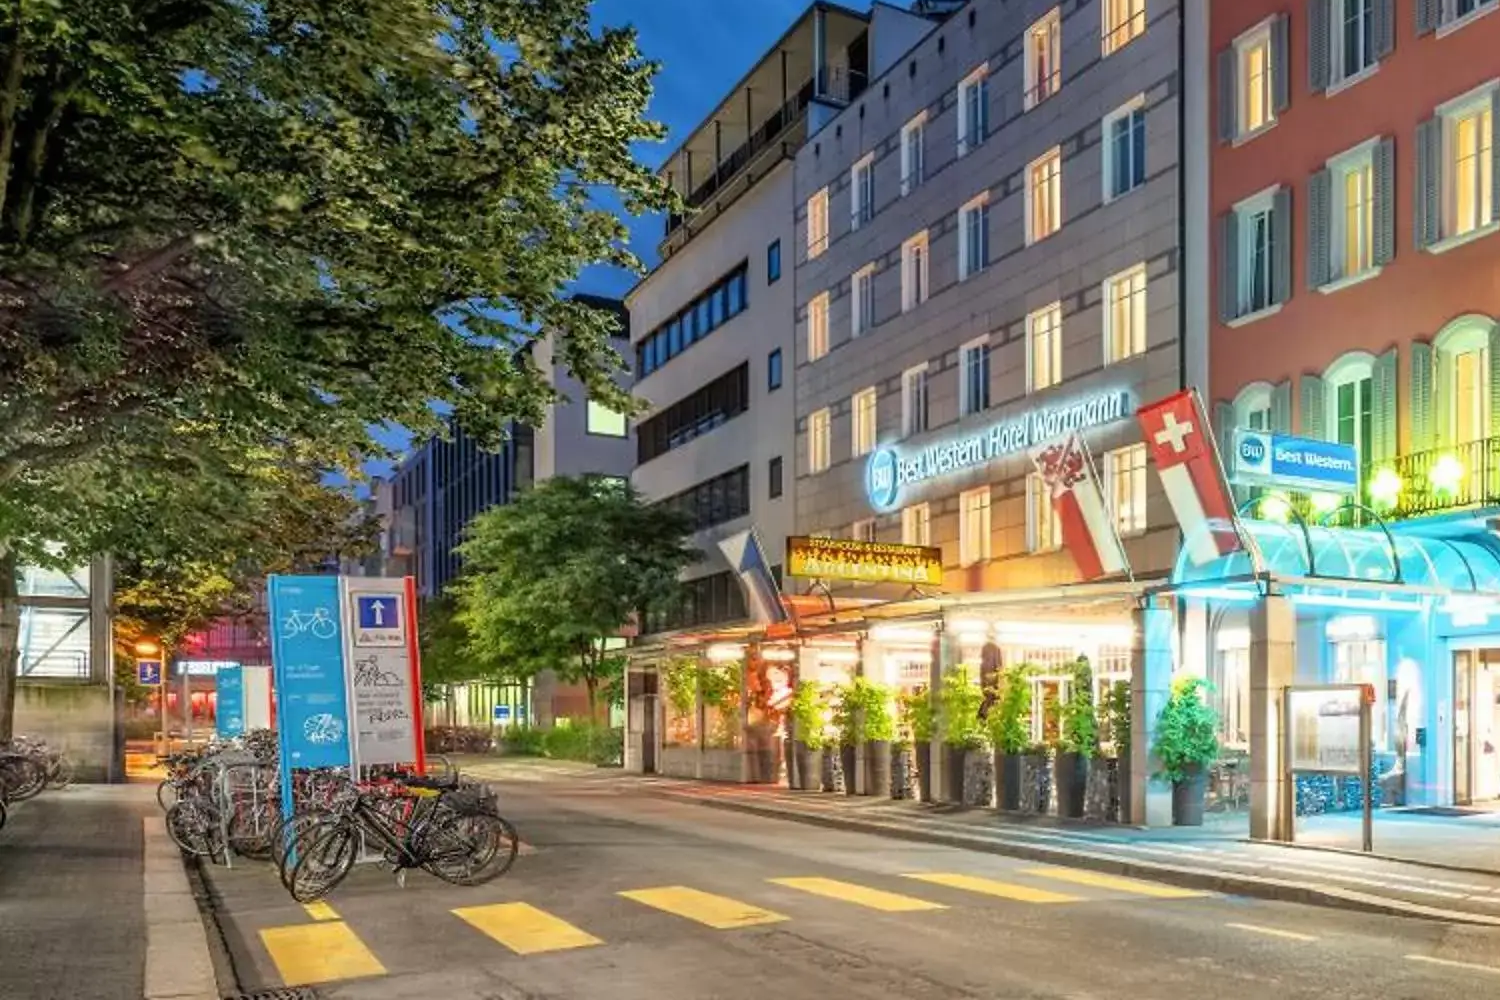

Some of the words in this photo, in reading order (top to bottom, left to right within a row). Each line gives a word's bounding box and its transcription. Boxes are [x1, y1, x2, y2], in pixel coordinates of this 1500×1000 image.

[897, 456, 925, 484] Best
[988, 414, 1029, 455] Hotel
[1033, 391, 1122, 443] Wartmann
[1275, 447, 1302, 464] Best
